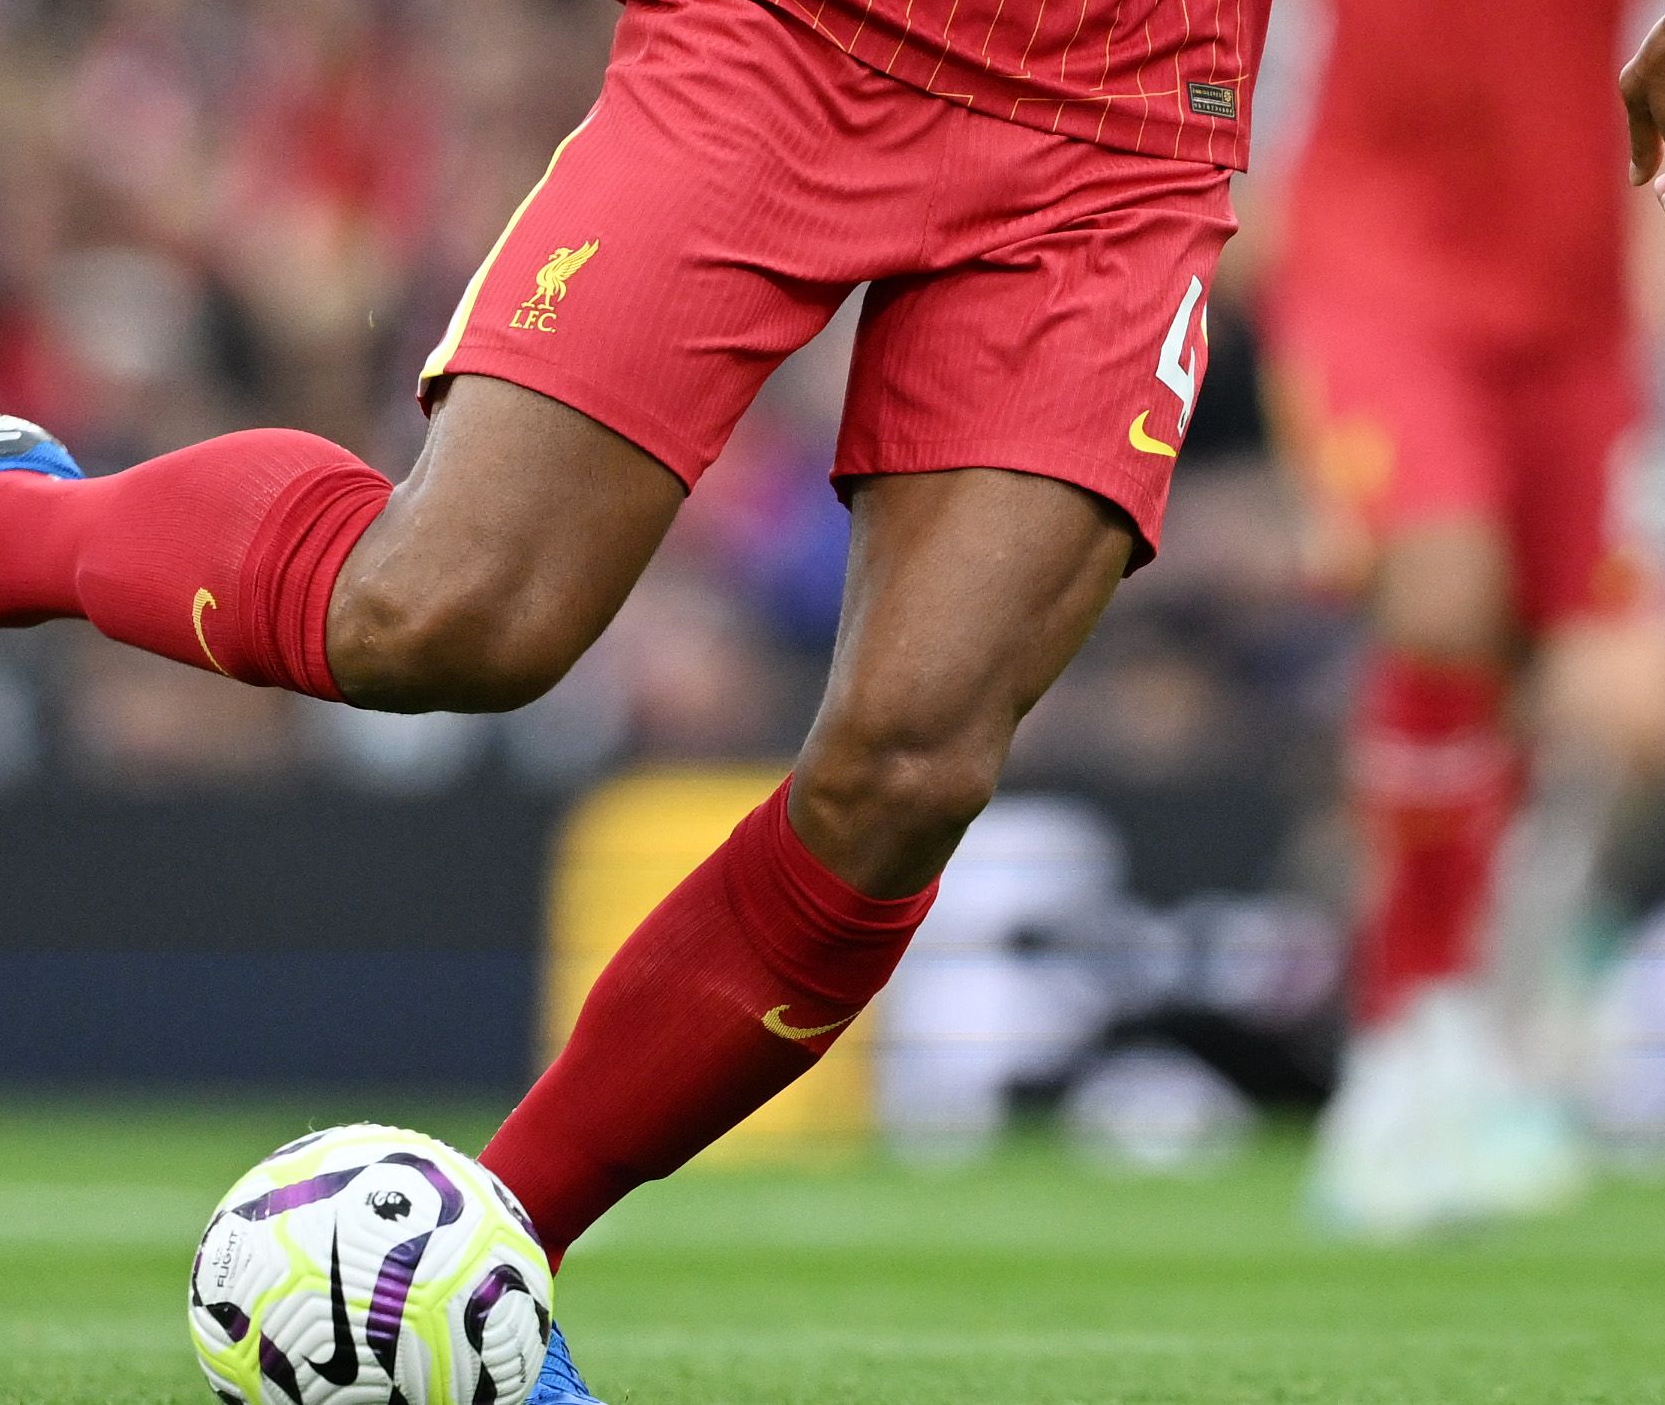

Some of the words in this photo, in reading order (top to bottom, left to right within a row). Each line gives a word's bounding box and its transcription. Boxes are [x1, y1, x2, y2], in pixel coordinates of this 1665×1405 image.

[508, 309, 558, 333] L.F.C.
[1155, 274, 1203, 439] 4
[217, 1228, 238, 1288] FLIGHT
